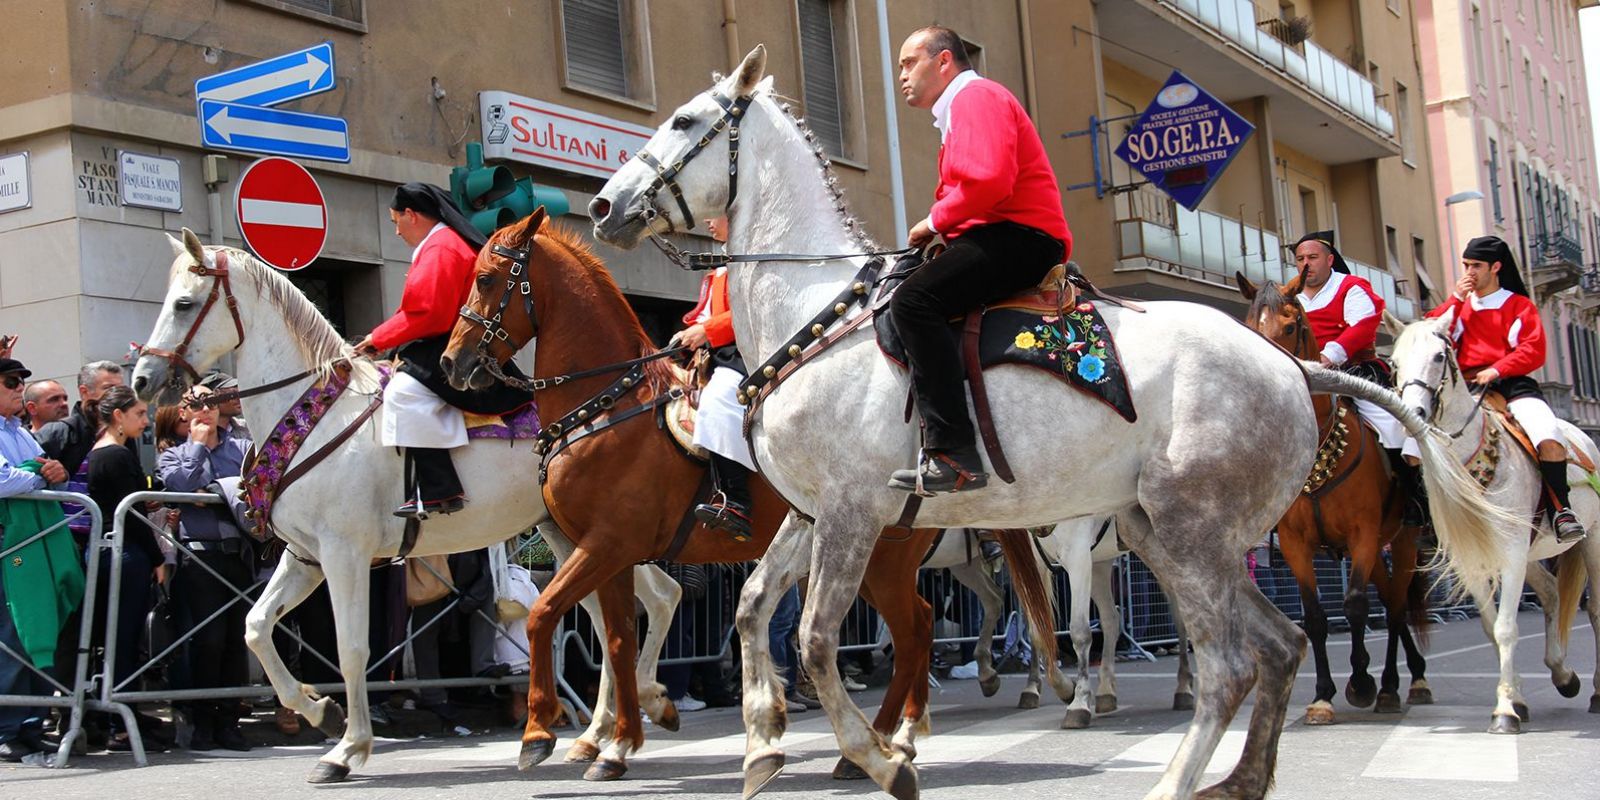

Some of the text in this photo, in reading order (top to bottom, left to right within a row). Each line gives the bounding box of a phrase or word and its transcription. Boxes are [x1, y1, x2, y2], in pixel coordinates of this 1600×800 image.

[1142, 109, 1219, 130] PRATICHE ASSICURATIVE
[1178, 104, 1209, 116] GESTIONE
[1127, 117, 1240, 163] SO.GE.P.A.
[142, 162, 160, 175] VIALE
[1143, 150, 1227, 172] GESTIONE SINISTRI
[124, 172, 151, 189] PASQUALE
[156, 177, 179, 192] MANCINI
